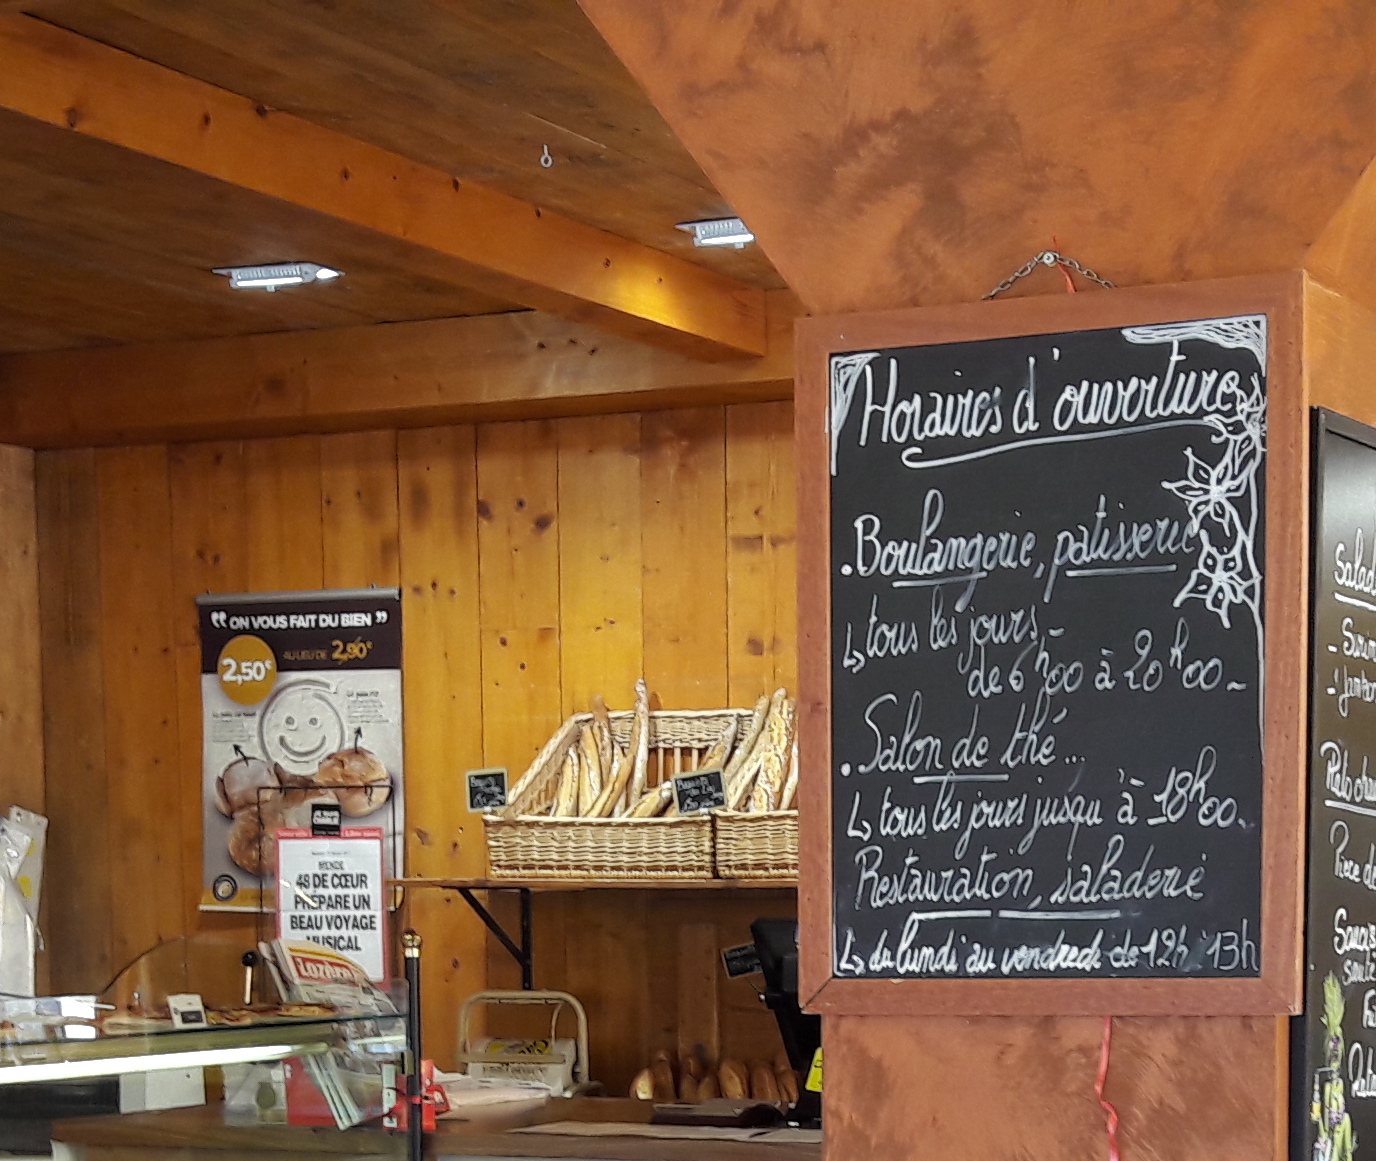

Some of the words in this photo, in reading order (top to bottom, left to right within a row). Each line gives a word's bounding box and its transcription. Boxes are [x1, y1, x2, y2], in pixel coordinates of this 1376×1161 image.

[860, 357, 1003, 446] Horaires
[229, 617, 250, 630] ON
[251, 615, 288, 629] VOUS
[290, 613, 317, 629] FAIT
[319, 613, 338, 628] DU
[341, 612, 372, 627] BIEN
[866, 594, 919, 658] tous
[929, 584, 958, 651] les
[967, 645, 1002, 698] de
[858, 690, 943, 774] Salon
[950, 705, 990, 769] de
[880, 787, 927, 838] tous
[313, 874, 330, 889] DE
[332, 874, 368, 889] CŒUR
[354, 894, 371, 910] UN
[290, 915, 323, 930] BEAU
[325, 914, 377, 931] VOYAGE
